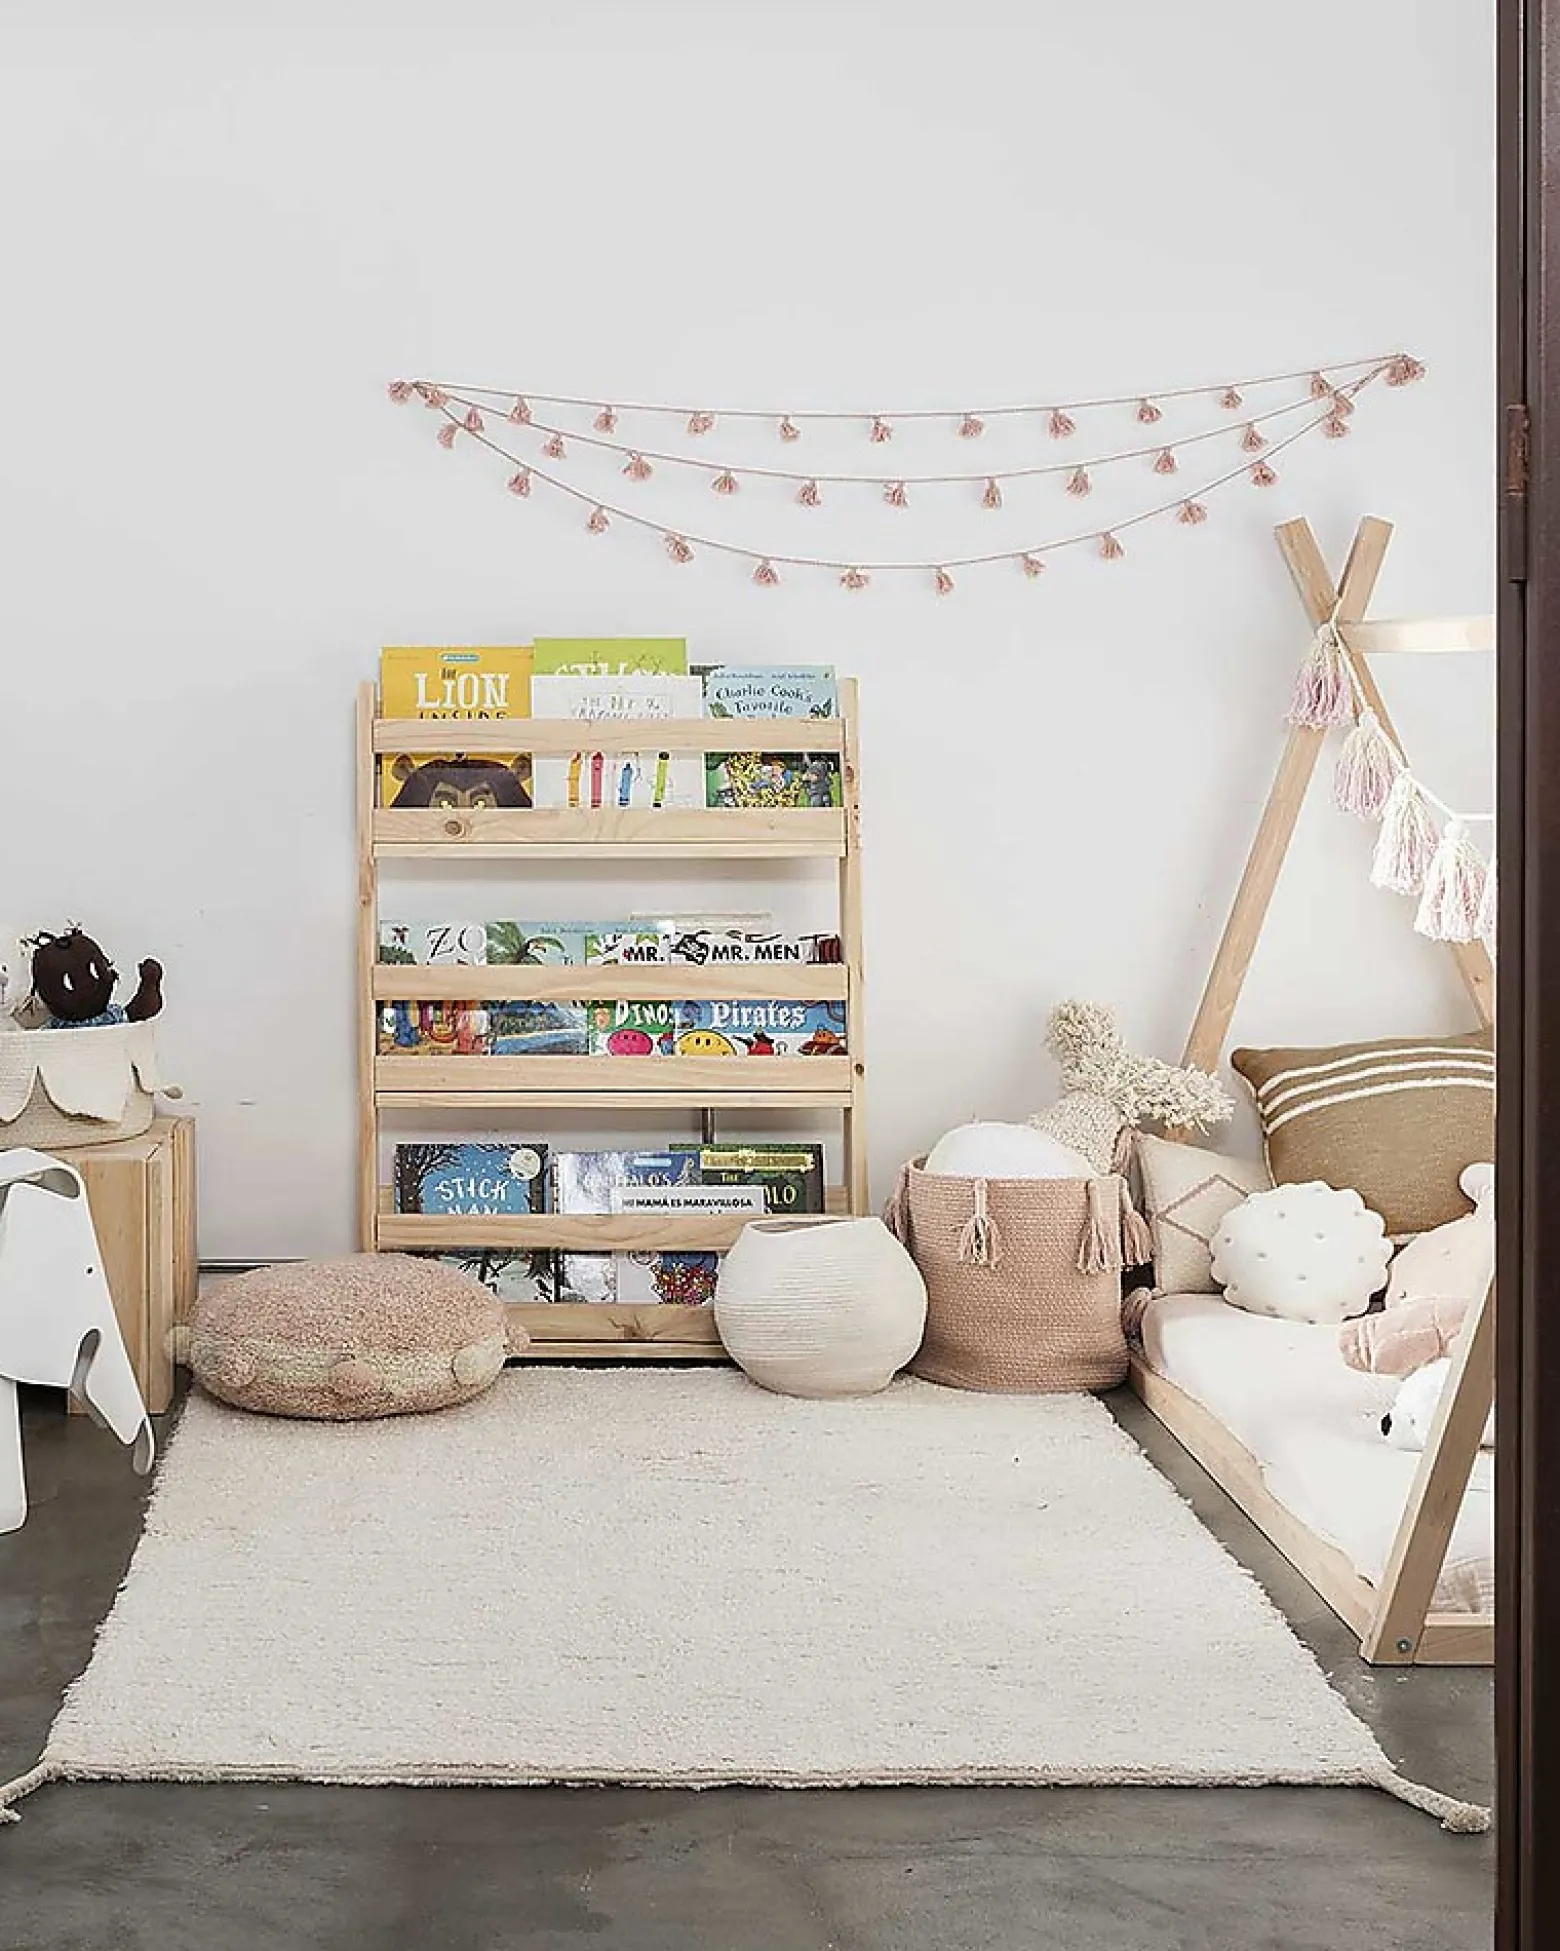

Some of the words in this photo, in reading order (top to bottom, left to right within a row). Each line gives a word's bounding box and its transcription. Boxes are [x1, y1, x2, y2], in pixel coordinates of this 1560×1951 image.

[414, 672, 510, 709] LION
[711, 945, 750, 961] MR.
[754, 945, 800, 961] MEN
[711, 1000, 807, 1029] Pirates
[435, 1178, 509, 1201] STICK
